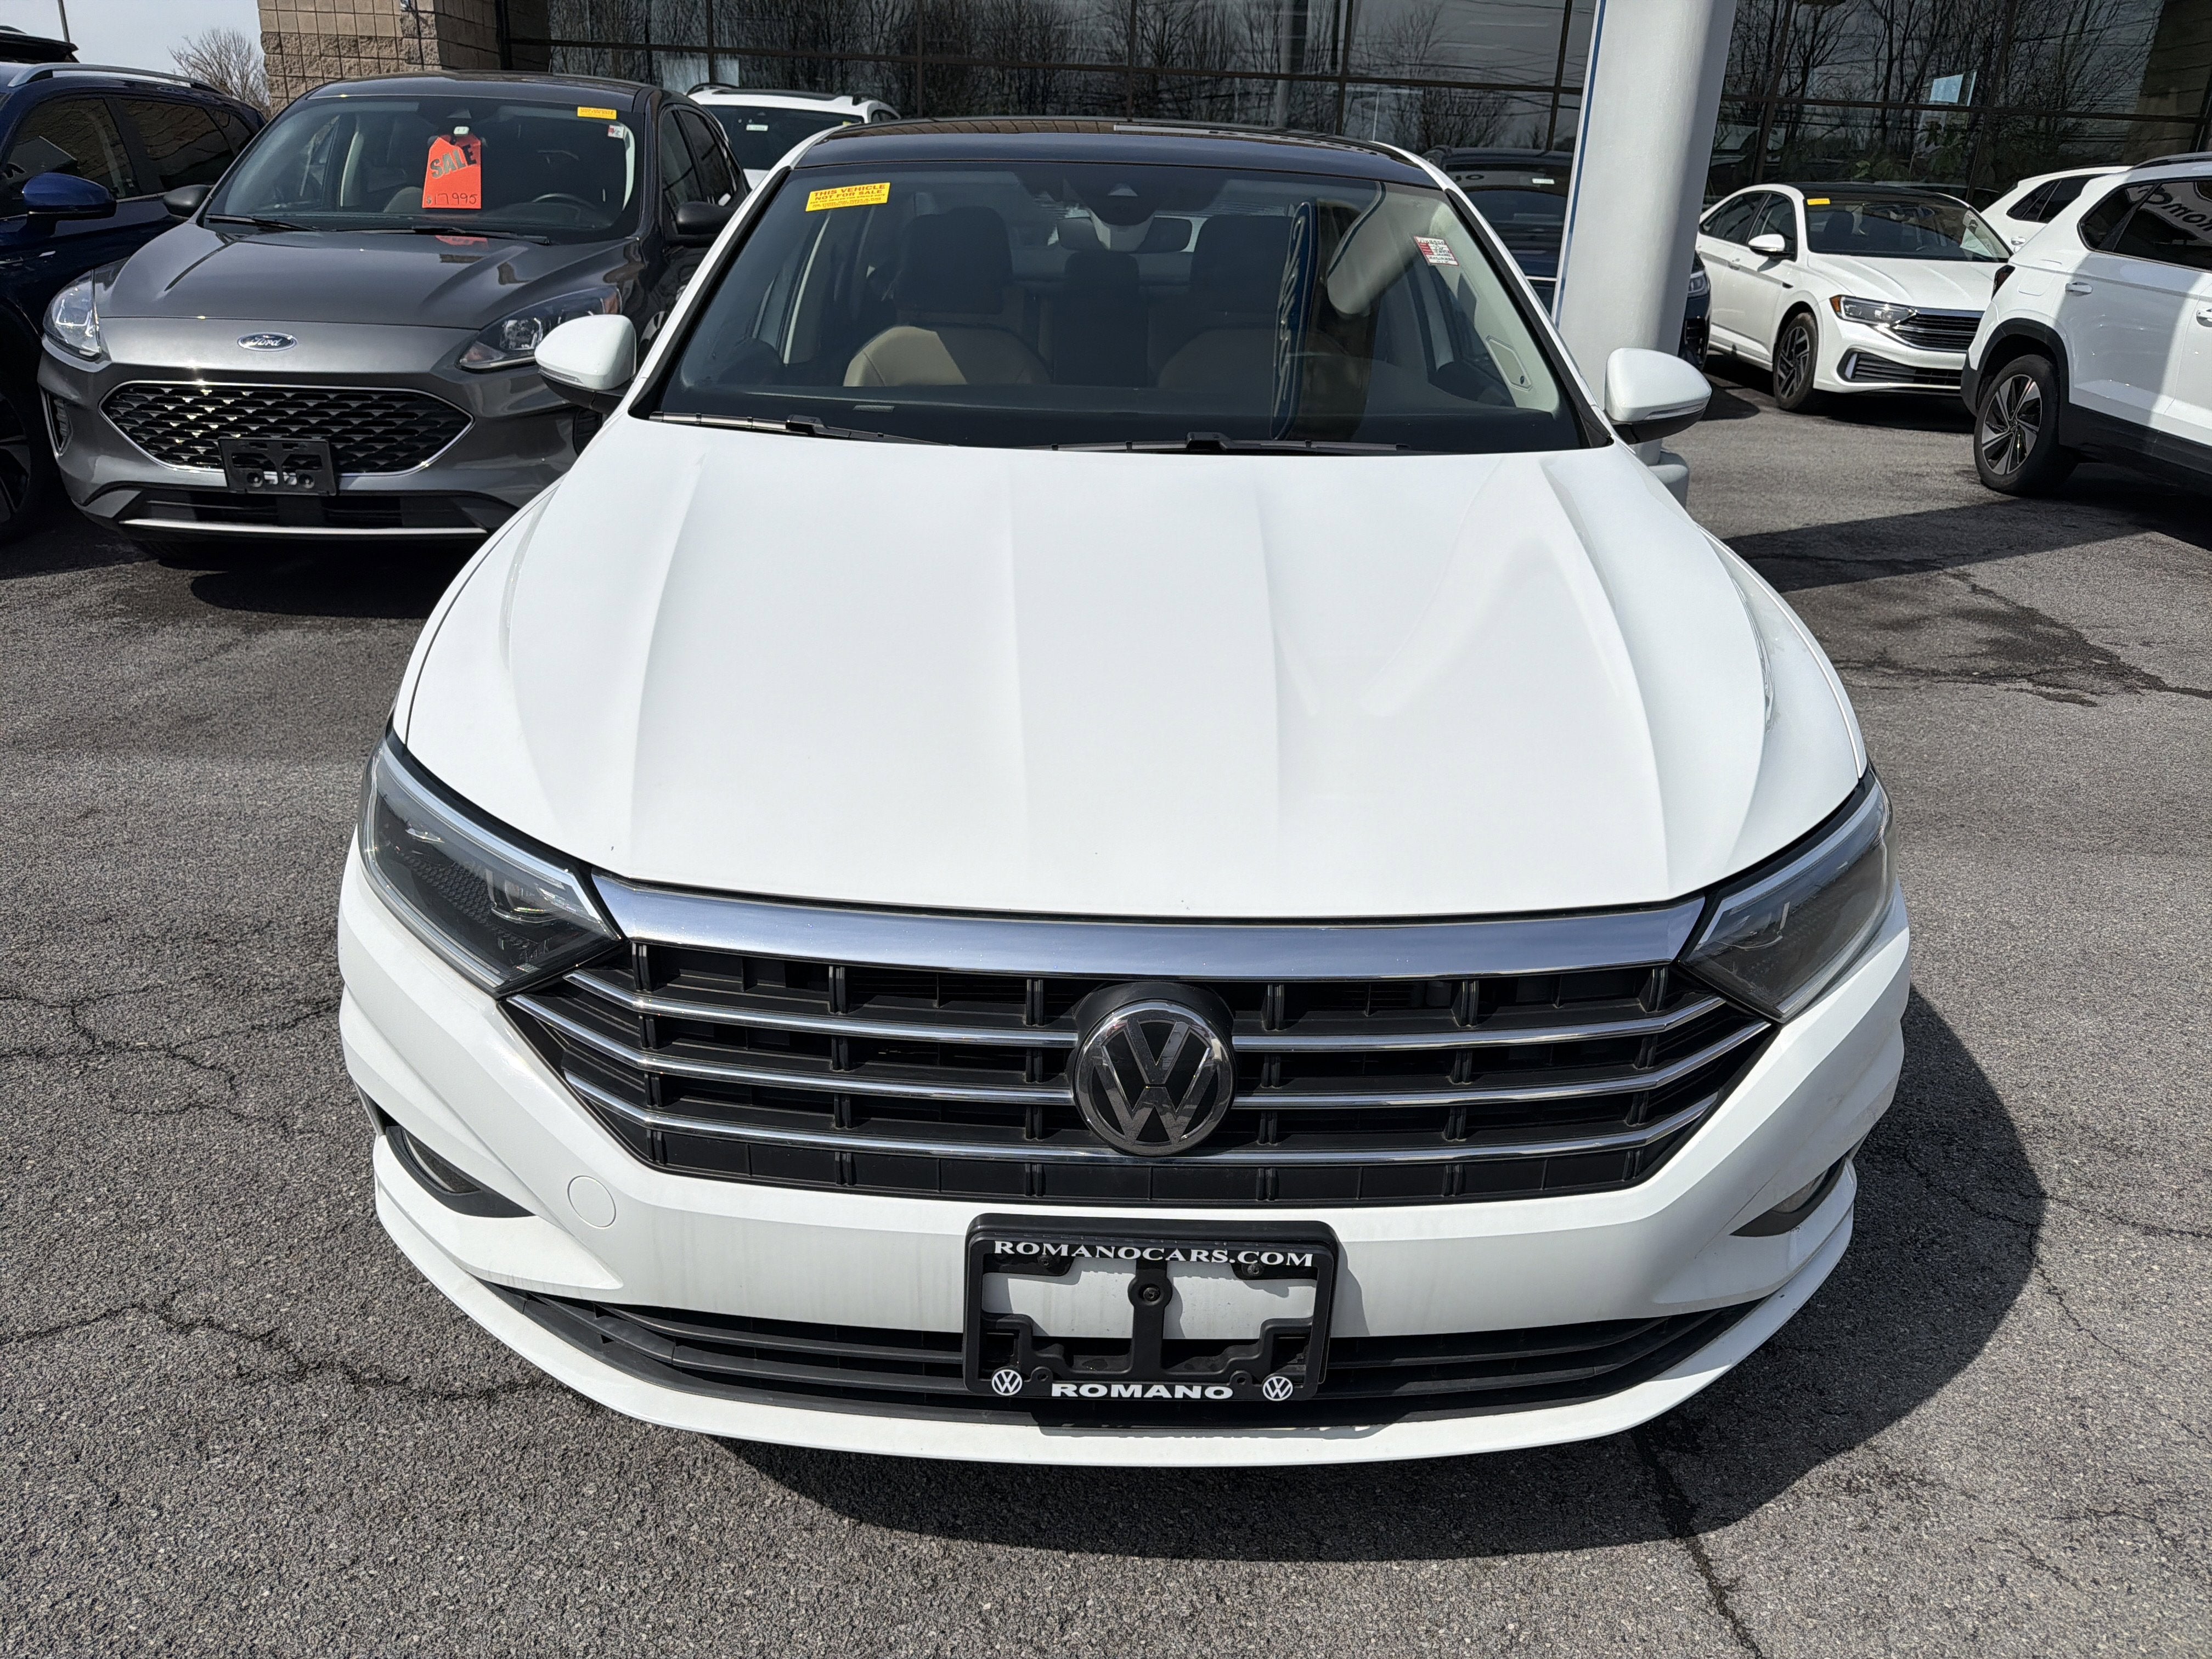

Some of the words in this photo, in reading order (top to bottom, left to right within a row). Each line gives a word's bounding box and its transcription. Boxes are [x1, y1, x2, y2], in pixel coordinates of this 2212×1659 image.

[430, 144, 477, 178] SALE
[841, 184, 885, 193] VEHICLE
[994, 1240, 1313, 1267] ROMANOCARS.COM
[1051, 1383, 1233, 1400] ROMANO
